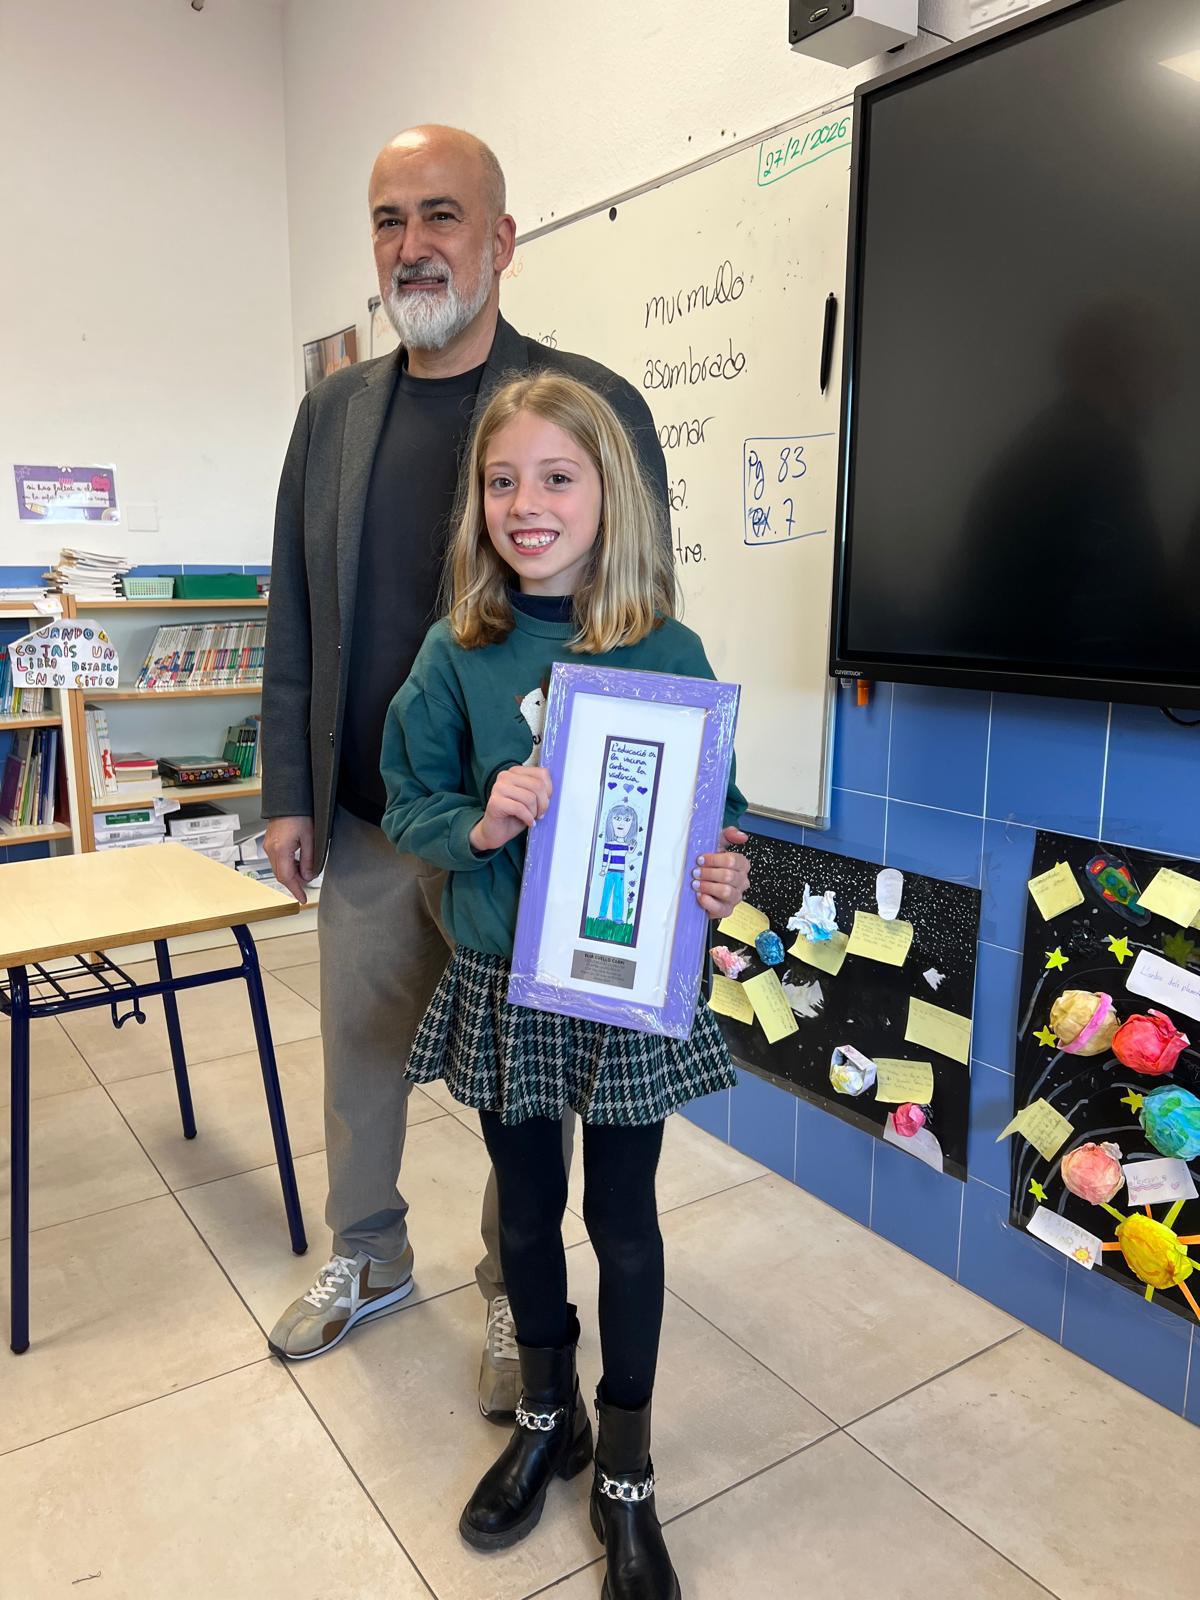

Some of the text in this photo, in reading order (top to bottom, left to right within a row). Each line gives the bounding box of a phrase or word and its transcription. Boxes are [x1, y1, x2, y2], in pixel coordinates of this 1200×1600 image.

[763, 116, 851, 177] 27/2/2026
[778, 446, 807, 482] 83
[782, 498, 796, 536] 7
[92, 646, 115, 660] UN
